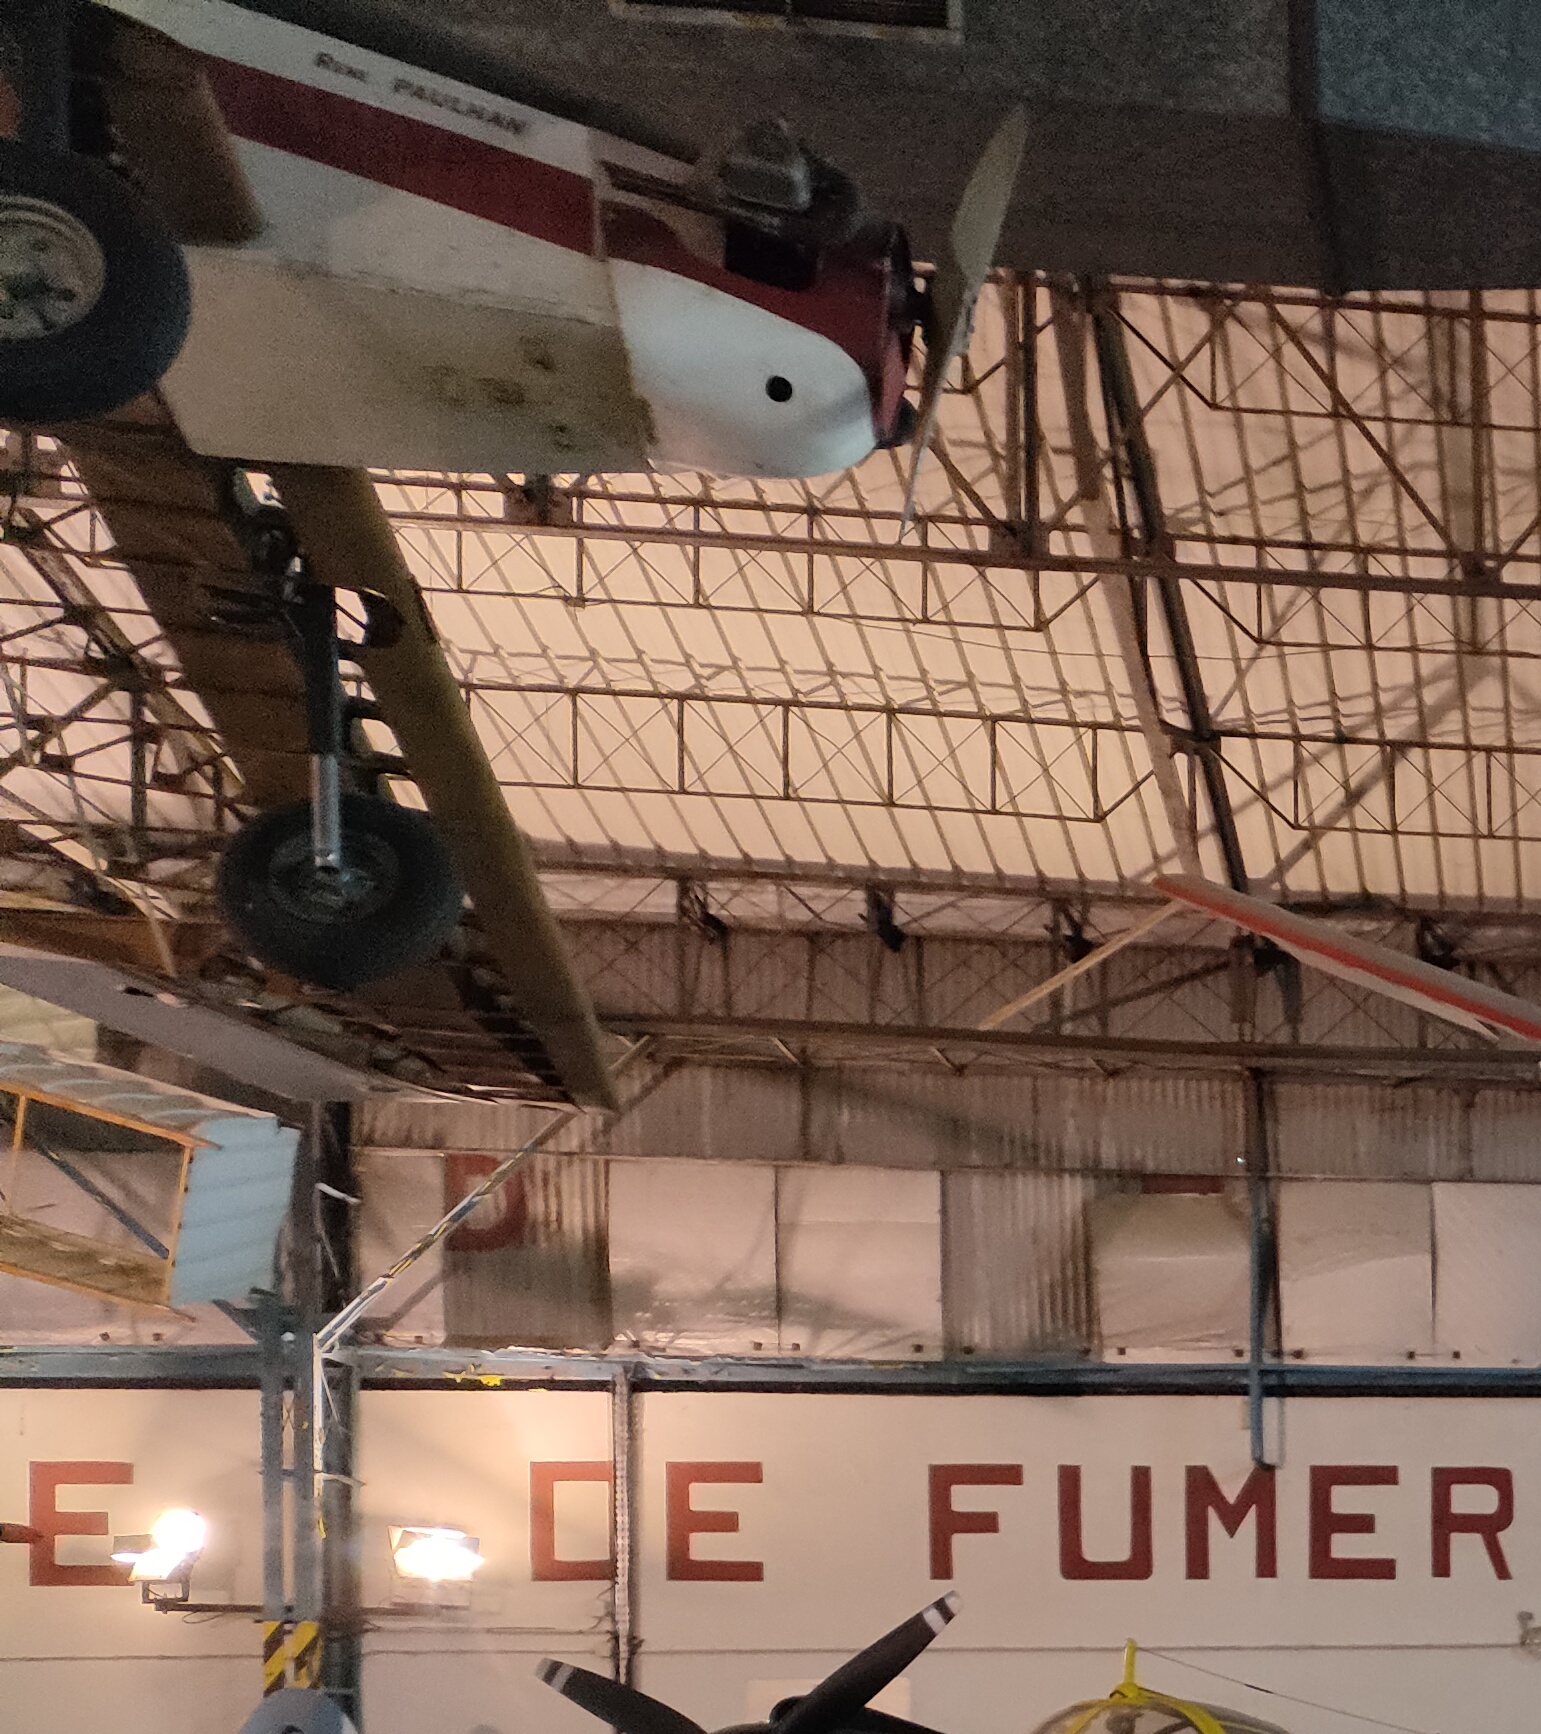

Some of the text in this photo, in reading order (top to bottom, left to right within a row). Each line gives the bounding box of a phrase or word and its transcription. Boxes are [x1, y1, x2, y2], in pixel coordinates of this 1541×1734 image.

[29, 1461, 1514, 1586] E DE FUMER
